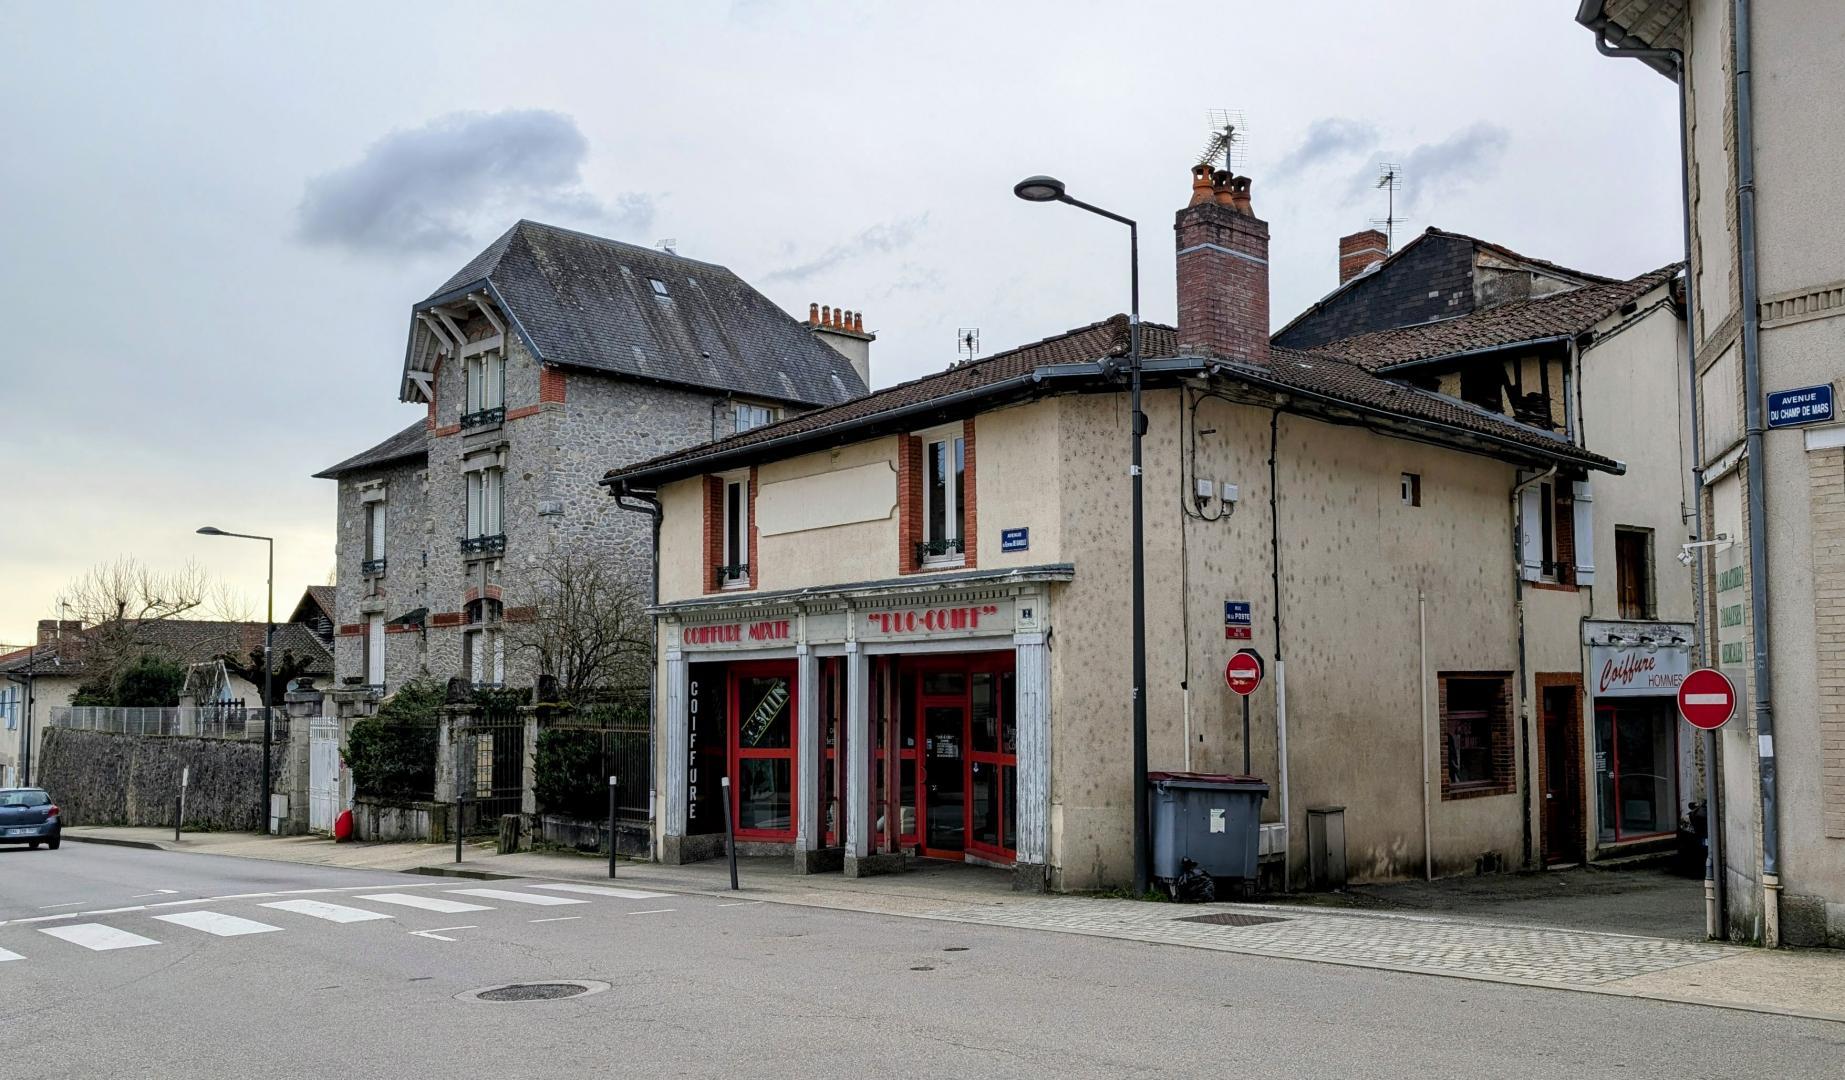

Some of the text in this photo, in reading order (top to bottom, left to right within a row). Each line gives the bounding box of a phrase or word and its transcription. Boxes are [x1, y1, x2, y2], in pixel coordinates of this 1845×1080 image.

[1782, 392, 1817, 405] AVENUE
[1770, 402, 1829, 420] DU CHAMP DE MARS
[1234, 612, 1250, 620] POSTE
[683, 619, 790, 645] COIFFURE MIXTE
[1600, 652, 1656, 692] Coiffure
[1648, 674, 1683, 687] HOMMES
[689, 681, 698, 819] COIFFURE
